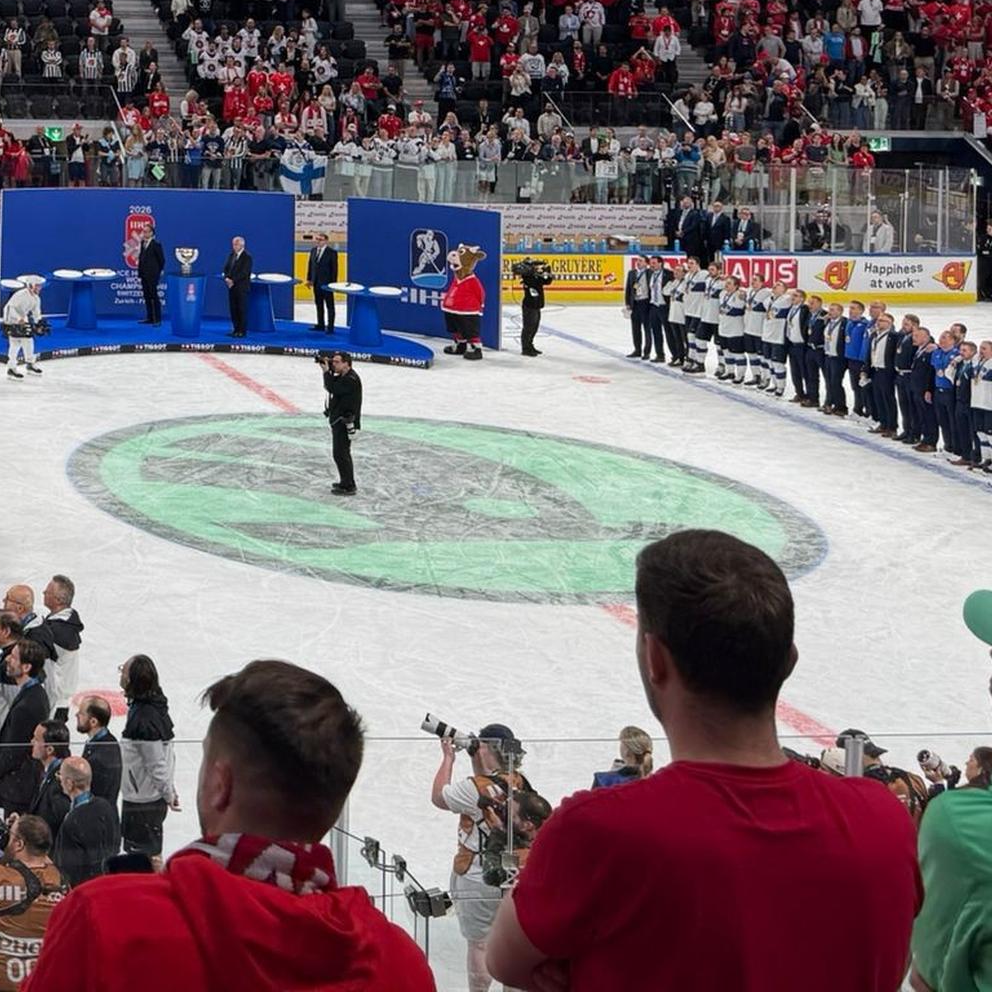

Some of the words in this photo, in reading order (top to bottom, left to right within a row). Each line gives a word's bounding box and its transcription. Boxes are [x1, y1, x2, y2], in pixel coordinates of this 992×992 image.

[129, 205, 152, 214] 2026
[552, 256, 603, 273] GRUYÈRE
[864, 261, 924, 276] Happiness
[870, 278, 882, 288] at
[293, 347, 320, 355] TISSOT
[400, 357, 426, 366] TISSOT
